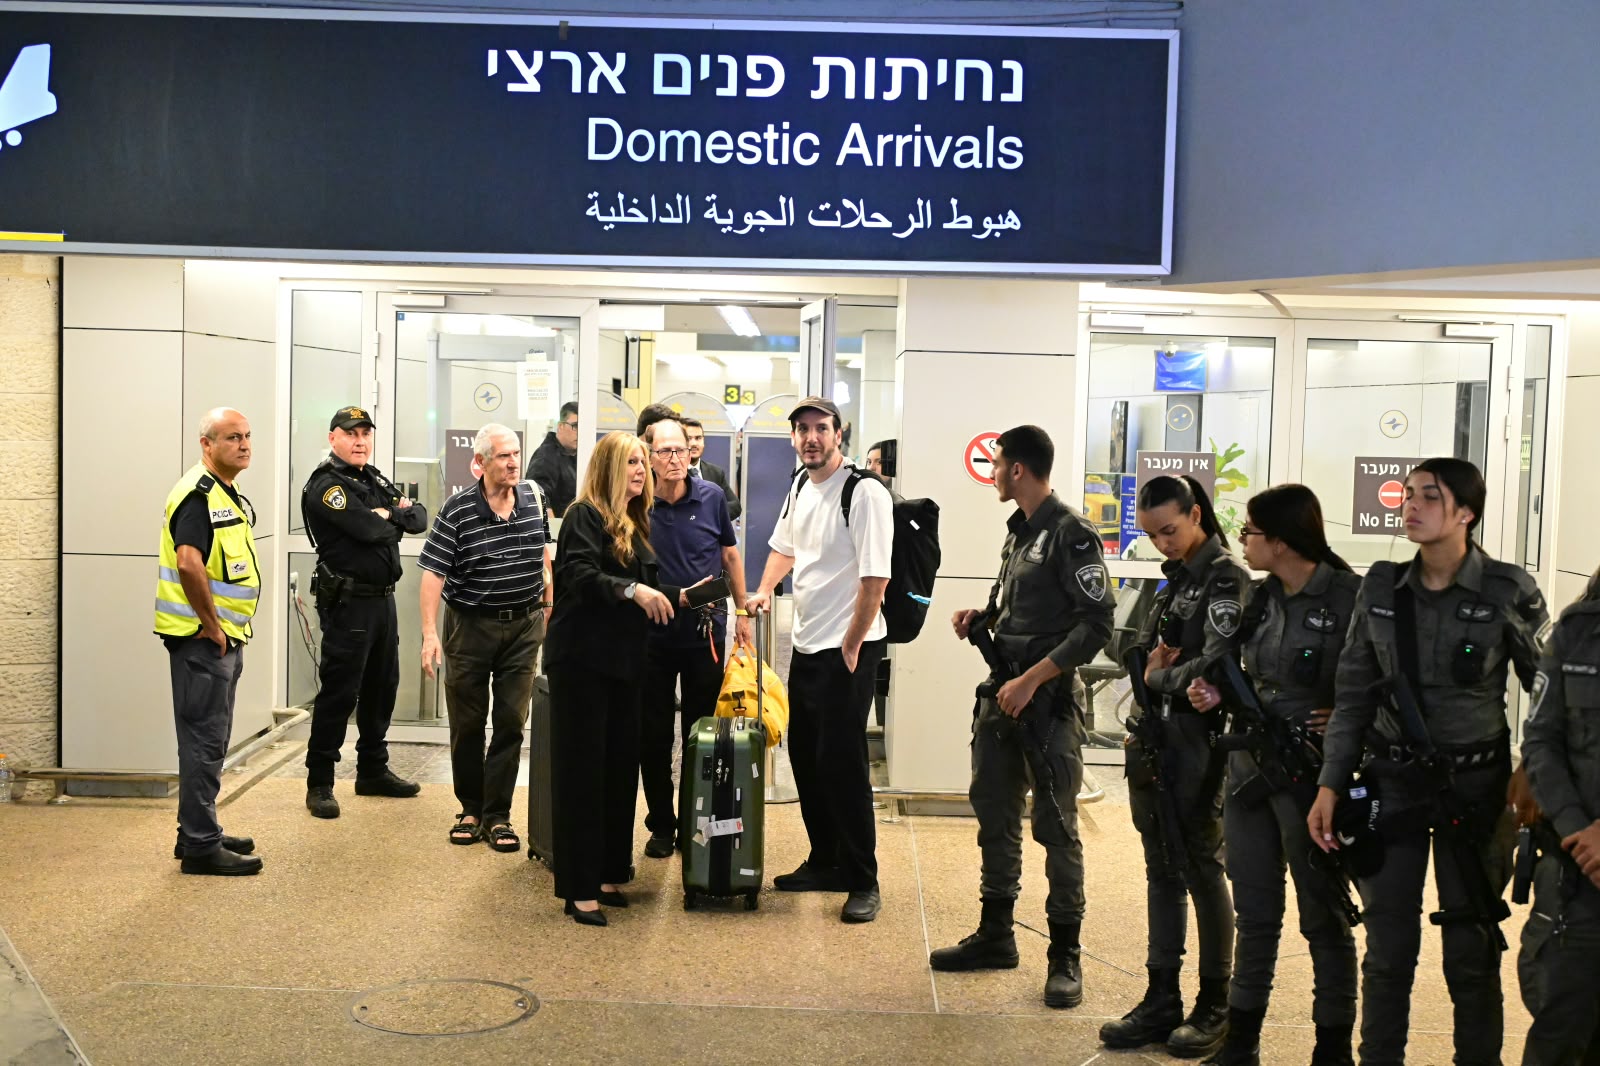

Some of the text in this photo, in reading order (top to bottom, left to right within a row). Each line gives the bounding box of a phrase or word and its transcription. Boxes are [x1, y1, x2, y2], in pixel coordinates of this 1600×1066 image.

[487, 49, 1023, 102] נחיתות פנים ארצי
[587, 117, 1024, 170] Domestic Arrivals
[585, 191, 1021, 239] هبوط الرحلات الجوية الداخلية
[726, 386, 739, 403] 3
[1143, 457, 1209, 473] אין מעבר
[1360, 463, 1400, 476] מעבר
[212, 509, 233, 519] POLICE
[1359, 512, 1380, 527] No
